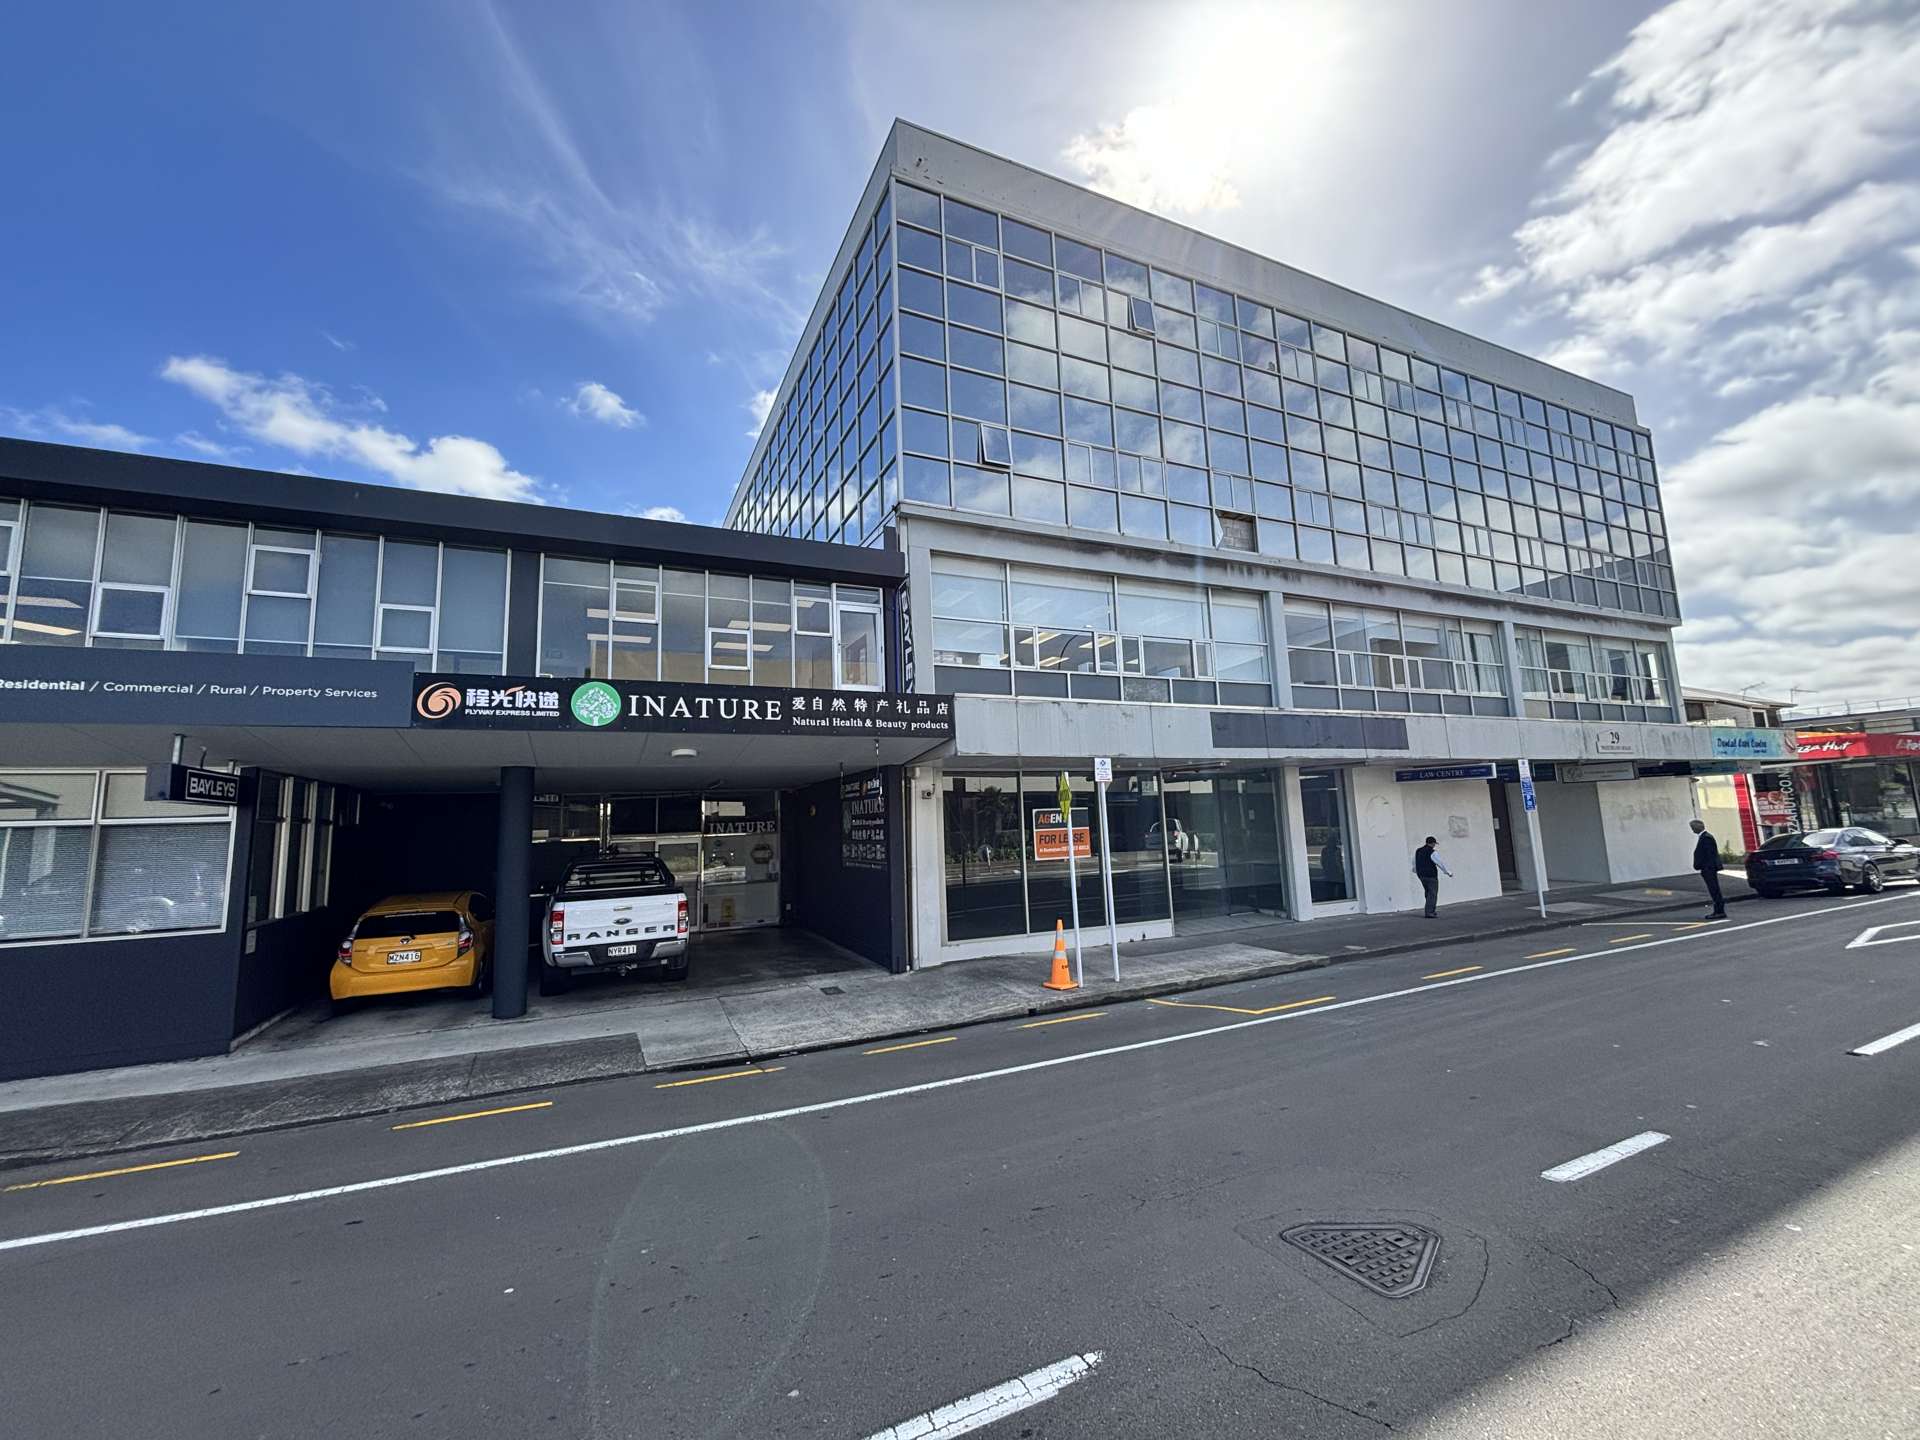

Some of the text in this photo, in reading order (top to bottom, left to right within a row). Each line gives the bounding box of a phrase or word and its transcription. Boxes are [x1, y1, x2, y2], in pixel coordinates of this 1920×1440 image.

[103, 682, 194, 694] Commercial
[210, 684, 246, 695] Rural
[262, 686, 321, 698] Property
[324, 688, 378, 698] Services
[465, 688, 559, 709] 程光快递
[792, 696, 949, 715] 爱自然特产礼品店
[496, 709, 531, 717] EXPRESS
[532, 710, 560, 718] LIMITED
[628, 695, 783, 721] INATURE
[792, 717, 949, 730] Natural Health & Beauty products
[1609, 731, 1620, 745] 29
[1796, 740, 1853, 754] zza Hut
[1436, 769, 1465, 778] CENTRE
[189, 777, 236, 798] BAYLEYS
[1038, 812, 1066, 825] AGEN
[709, 820, 776, 834] INATURE
[1039, 832, 1085, 845] FOR LESE
[567, 924, 676, 941] RANGER
[389, 951, 420, 962] MZN416
